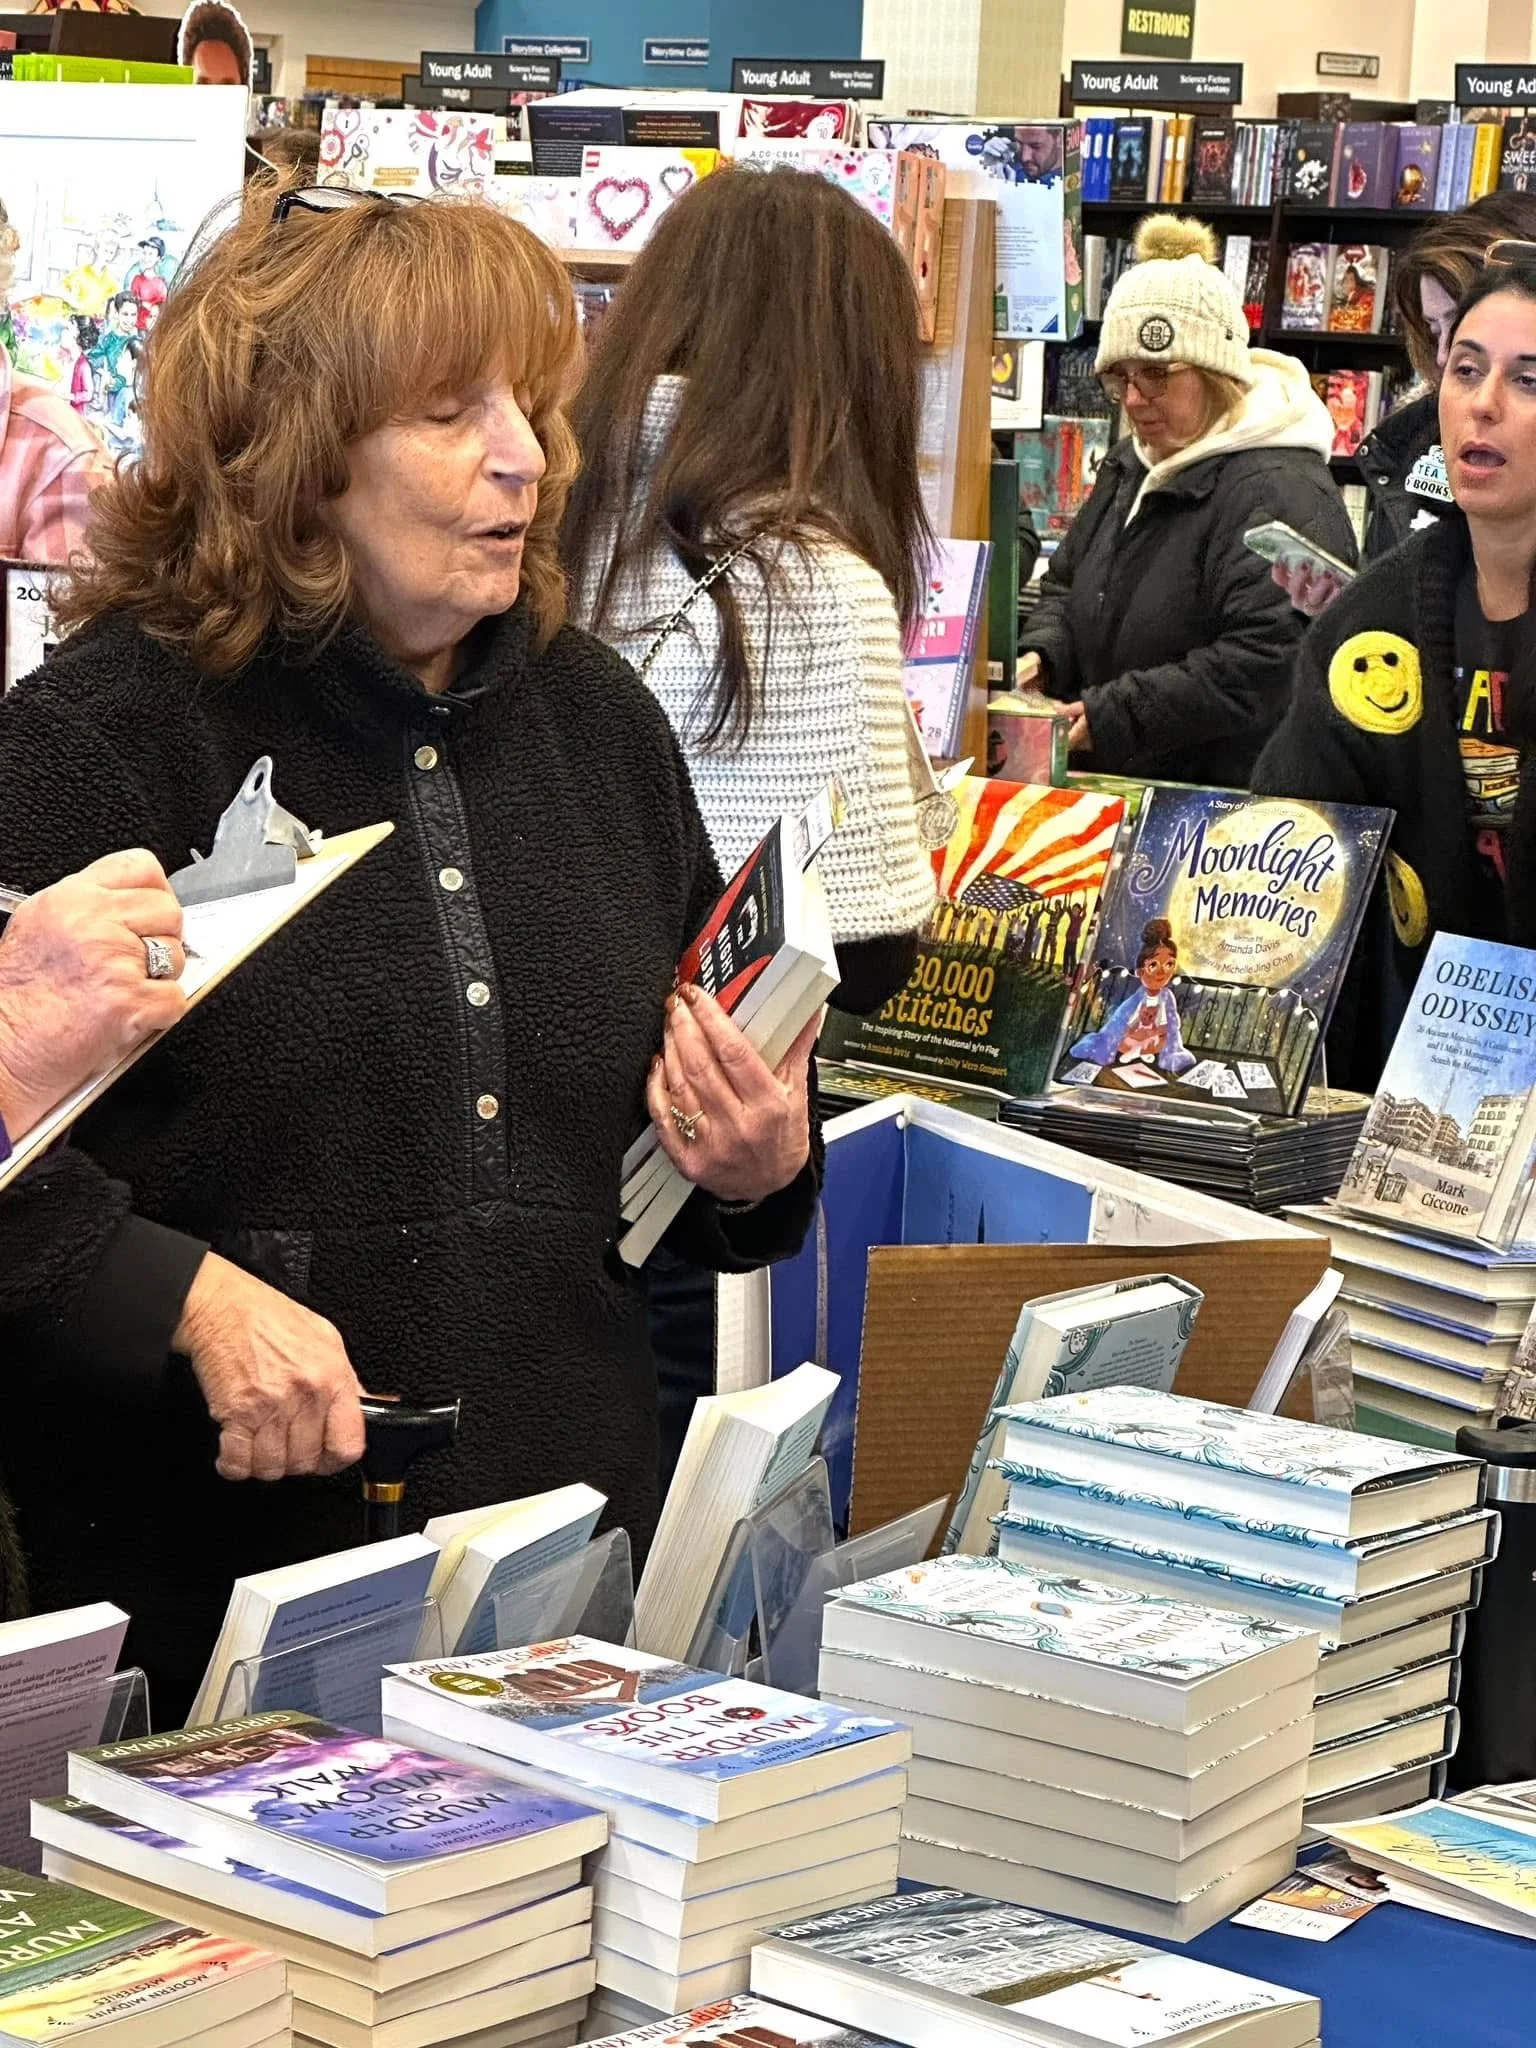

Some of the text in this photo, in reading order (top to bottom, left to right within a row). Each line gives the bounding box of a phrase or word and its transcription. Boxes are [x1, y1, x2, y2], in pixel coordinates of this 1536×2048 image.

[1128, 9, 1190, 38] RESTROOMS
[429, 63, 493, 81] Young Adult
[742, 70, 810, 87] Young Adult
[1081, 73, 1158, 93] Young Adult
[1180, 75, 1230, 84] Science Fiction
[1467, 77, 1536, 97] Young Ad
[1503, 150, 1536, 165] SWEE
[1419, 464, 1439, 478] TEA
[1413, 479, 1450, 496] BOOKS
[1214, 800, 1234, 811] Story
[1129, 818, 1335, 896] Moonlight
[1194, 883, 1316, 938] Memories
[717, 924, 734, 983] NIGHT
[1218, 939, 1280, 954] Amanda Davis
[1272, 952, 1295, 967] Chan
[907, 954, 995, 1004] 30,000
[861, 1022, 873, 1032] The
[874, 1024, 903, 1039] Inspiring
[903, 1030, 921, 1042] Story
[922, 1033, 931, 1042] of
[931, 1034, 942, 1045] the
[942, 1036, 971, 1050] National
[986, 1045, 1000, 1057] Flag
[1434, 1179, 1467, 1198] Mark
[1421, 1192, 1469, 1217] Ciccone
[408, 1660, 474, 1677] KNAPP
[584, 1695, 721, 1736] BOOKS
[102, 1714, 291, 1759] CHRISTINE KNAPP
[624, 1726, 706, 1748] THE
[662, 1715, 815, 1761] MURDER
[254, 1764, 383, 1799] WALK
[260, 1770, 463, 1821] WIDOW'S
[337, 1792, 510, 1840] MURDER
[344, 1793, 442, 1822] ON THE
[424, 1819, 537, 1849] MODERN MIDWIFE
[431, 1819, 496, 1839] MYSTERIES
[780, 1890, 965, 1939] CHRISTINE KNAPP
[852, 1909, 1048, 1962] FIRST LIGHT
[976, 1937, 1020, 1956] AT
[973, 1942, 1113, 1985] MURDER
[88, 1973, 209, 2020] MODERN MIDWIFE
[93, 1976, 166, 2005] MYSTERIES
[627, 1999, 739, 2042] CHRISTINE
